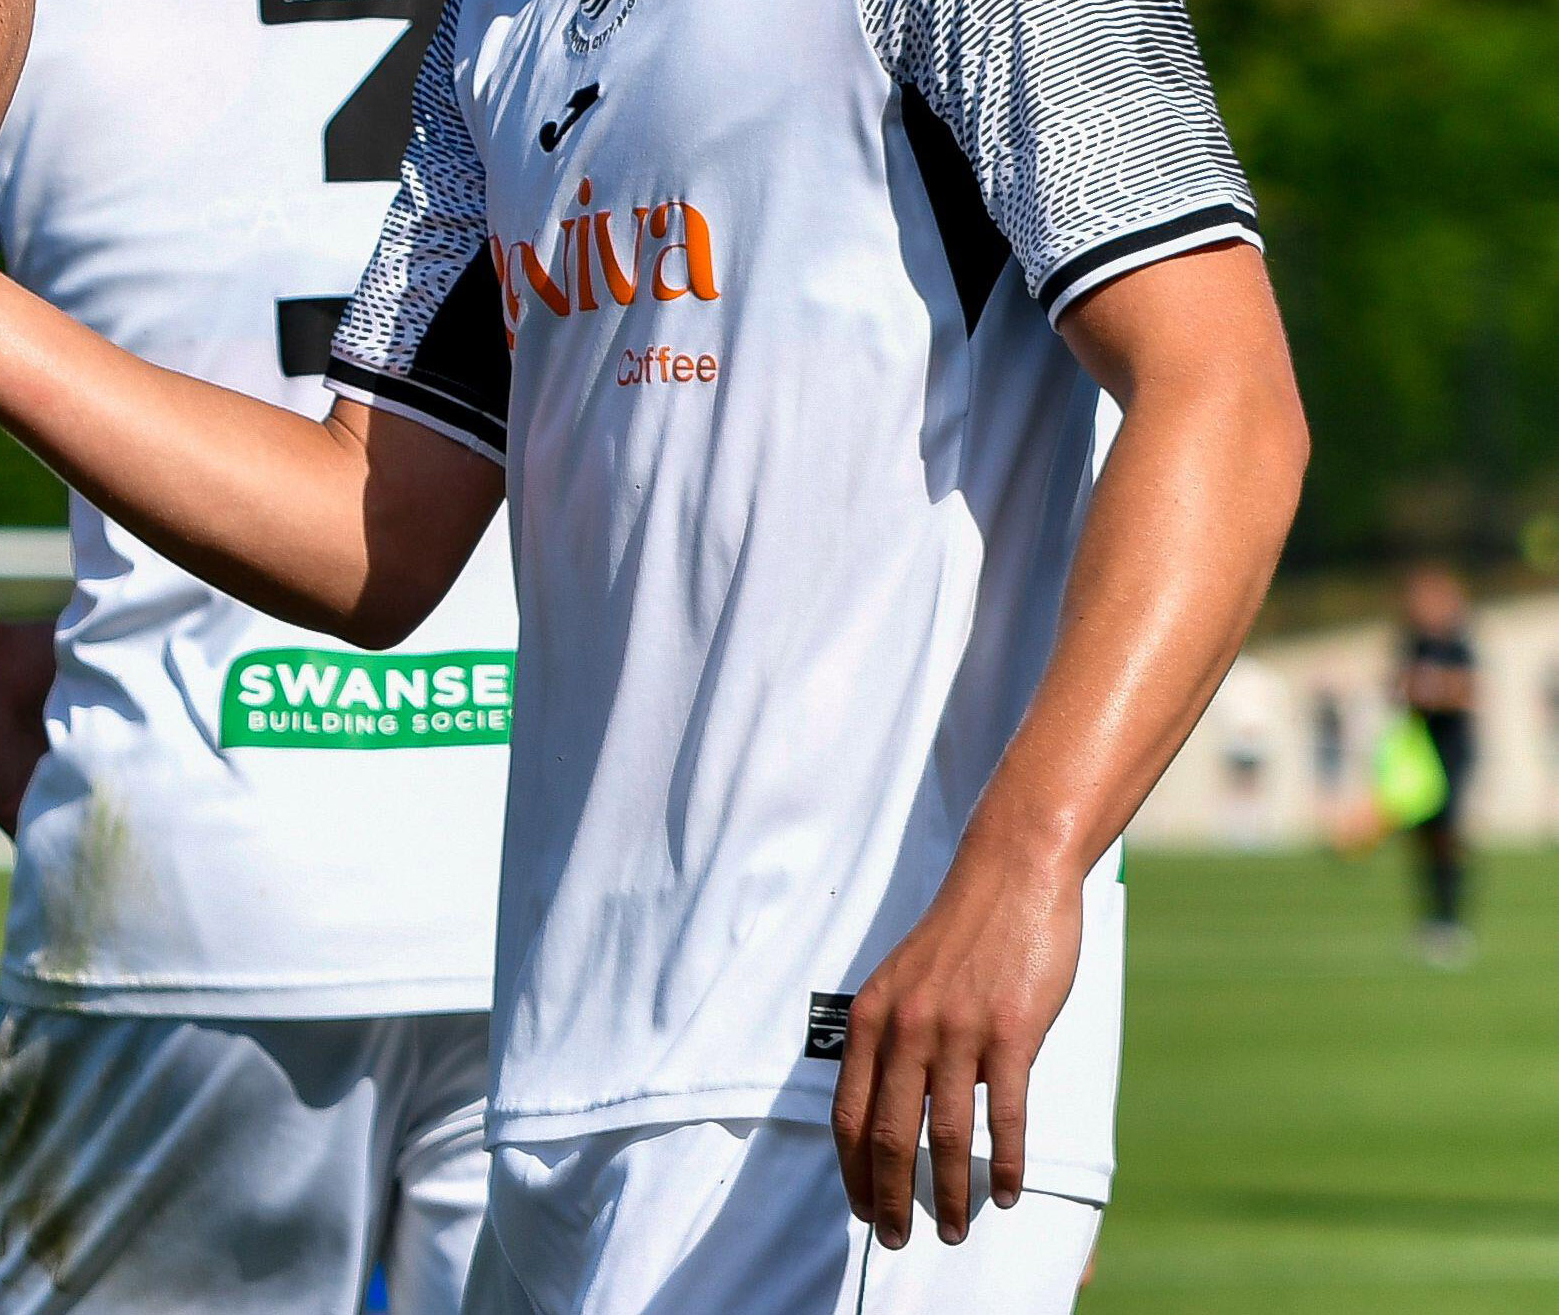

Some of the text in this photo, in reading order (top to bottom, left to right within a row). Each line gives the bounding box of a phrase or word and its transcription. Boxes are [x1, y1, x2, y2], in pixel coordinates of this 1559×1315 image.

[238, 662, 511, 710] SWANSE
[248, 709, 513, 735] BUILDING SOCIE
